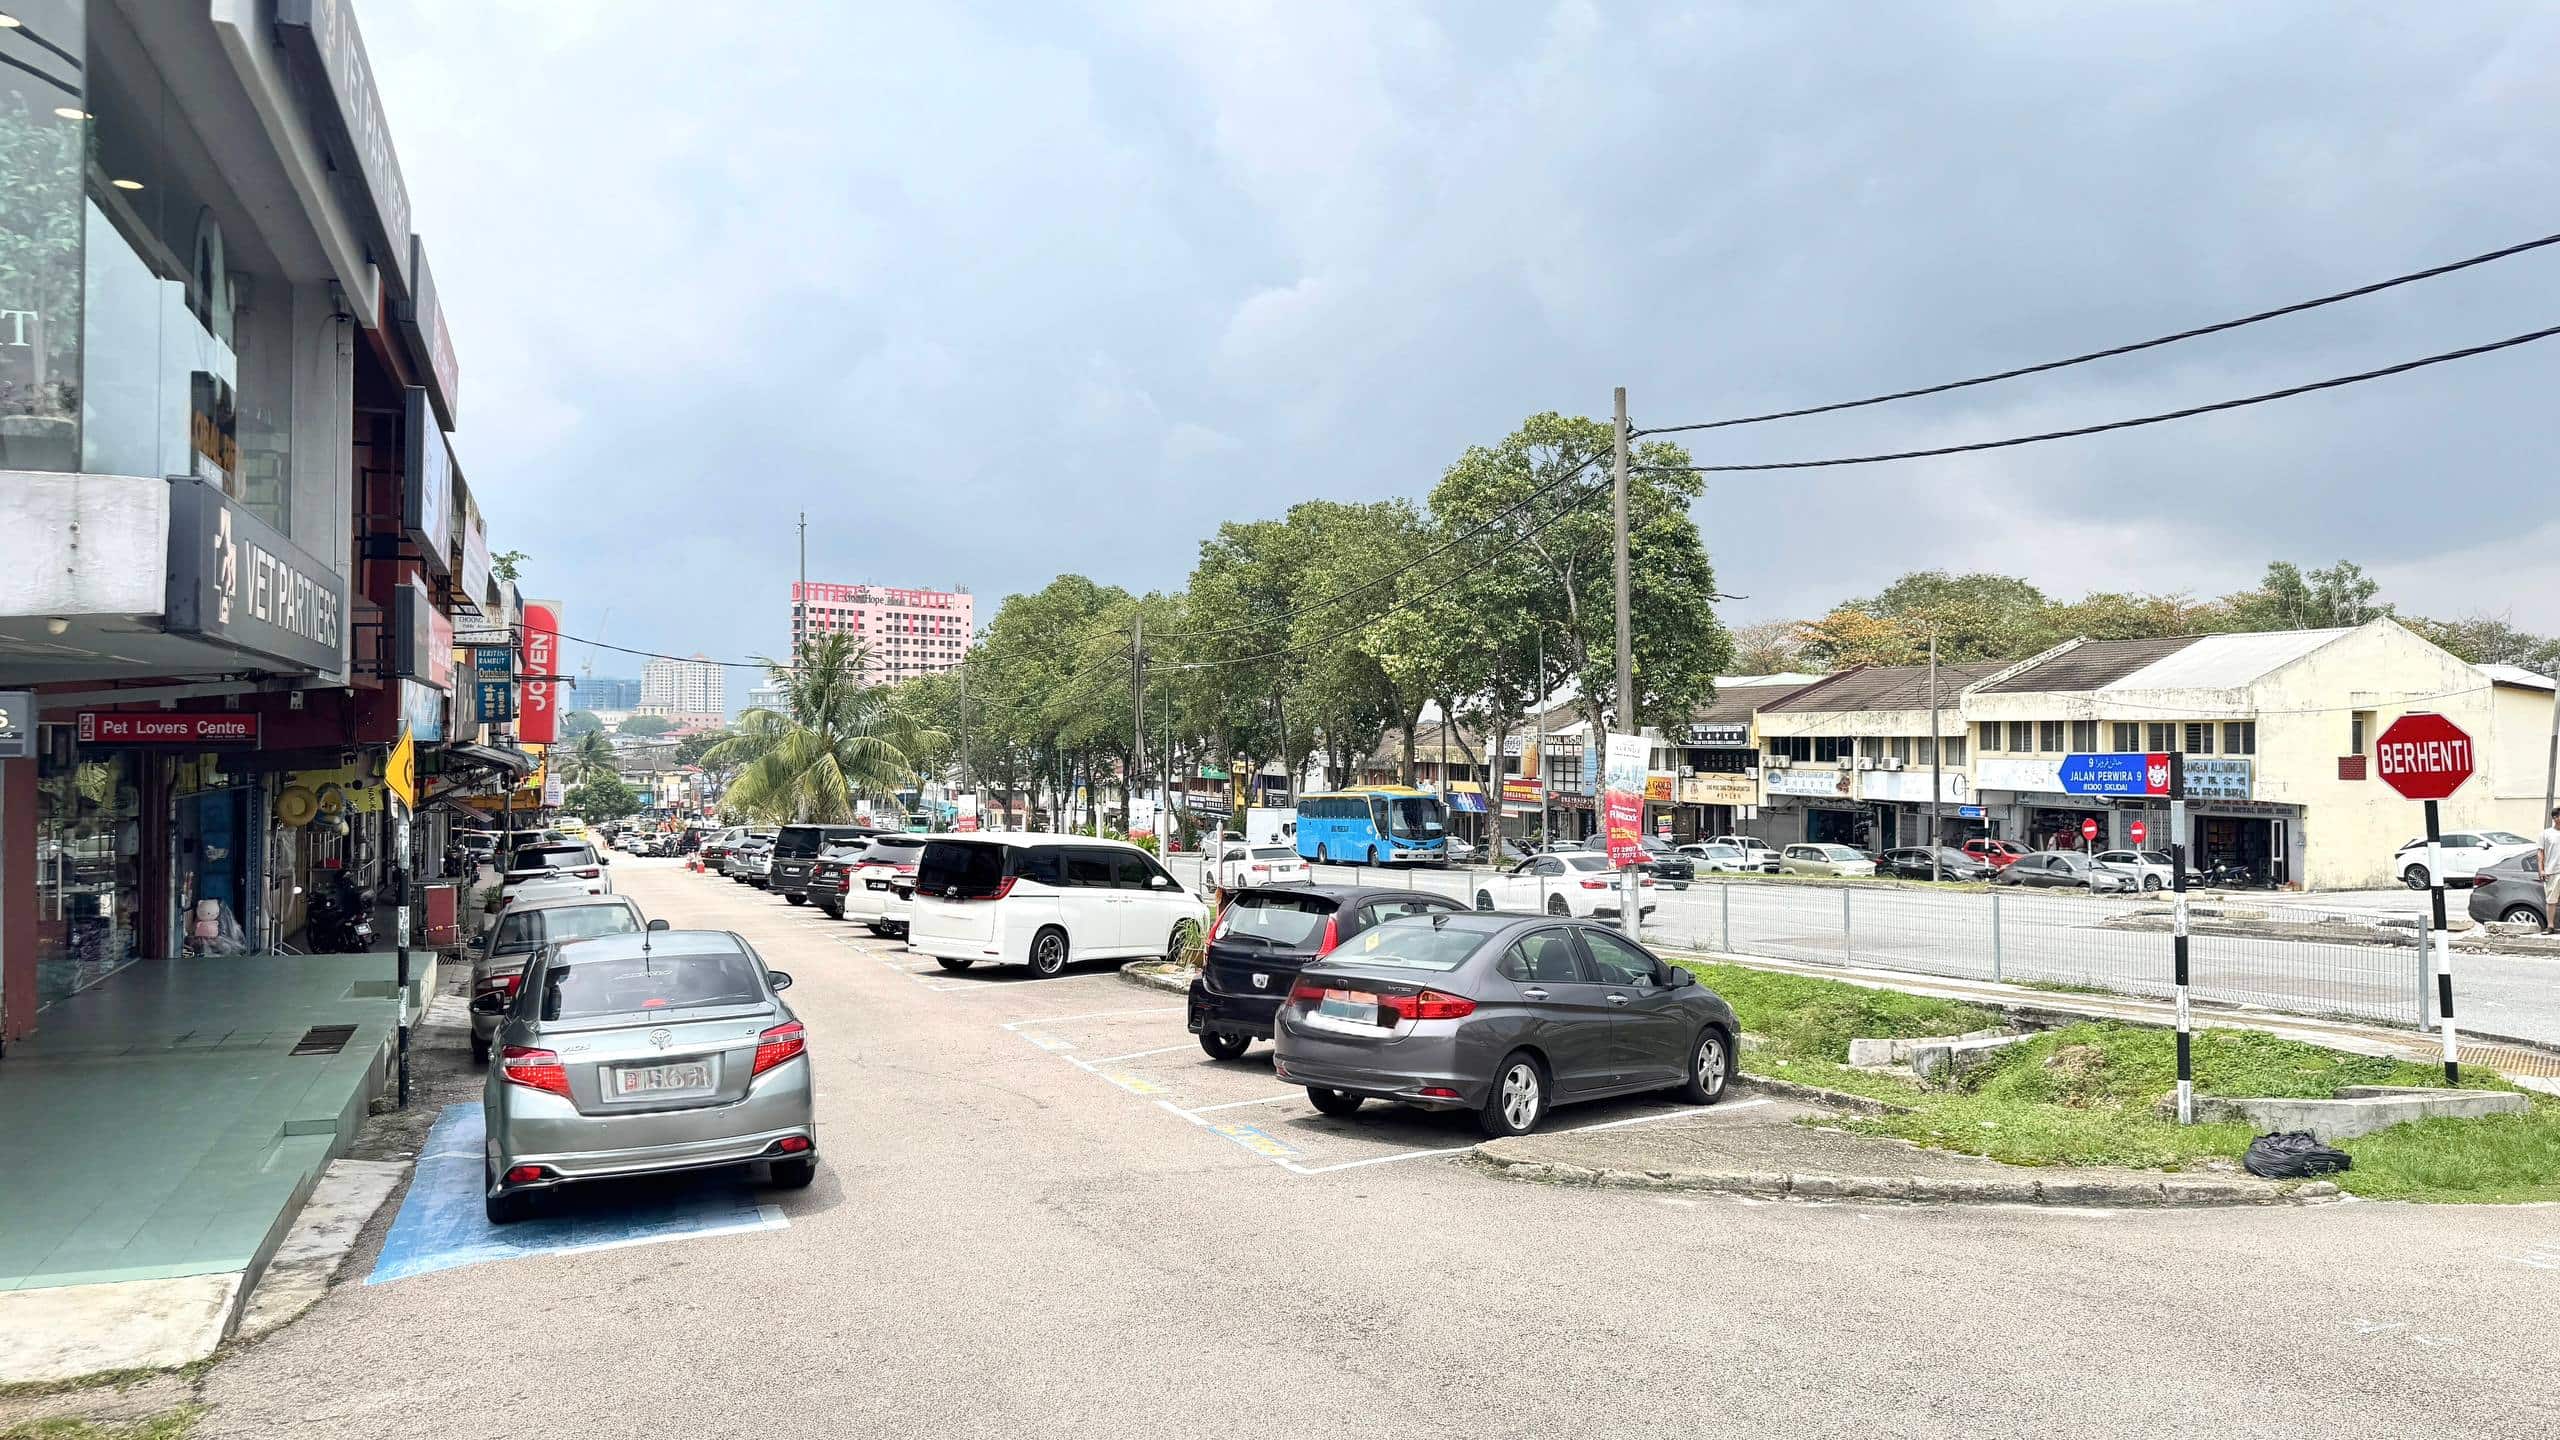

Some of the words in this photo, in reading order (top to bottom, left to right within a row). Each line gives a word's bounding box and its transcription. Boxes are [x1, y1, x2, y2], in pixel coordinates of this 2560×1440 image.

[342, 12, 364, 131] VET
[365, 87, 407, 261] PARTNERS
[246, 540, 276, 623] VET
[278, 561, 337, 649] PARTNERS
[528, 630, 548, 711] JOVEN
[103, 720, 128, 734] Pet
[136, 720, 188, 734] Lovers
[196, 720, 246, 734] Centre
[2070, 771, 2095, 781] JALAN
[2098, 771, 2133, 781] PERWIRA
[2136, 771, 2143, 781] 9
[2380, 740, 2469, 774] BERHENTI
